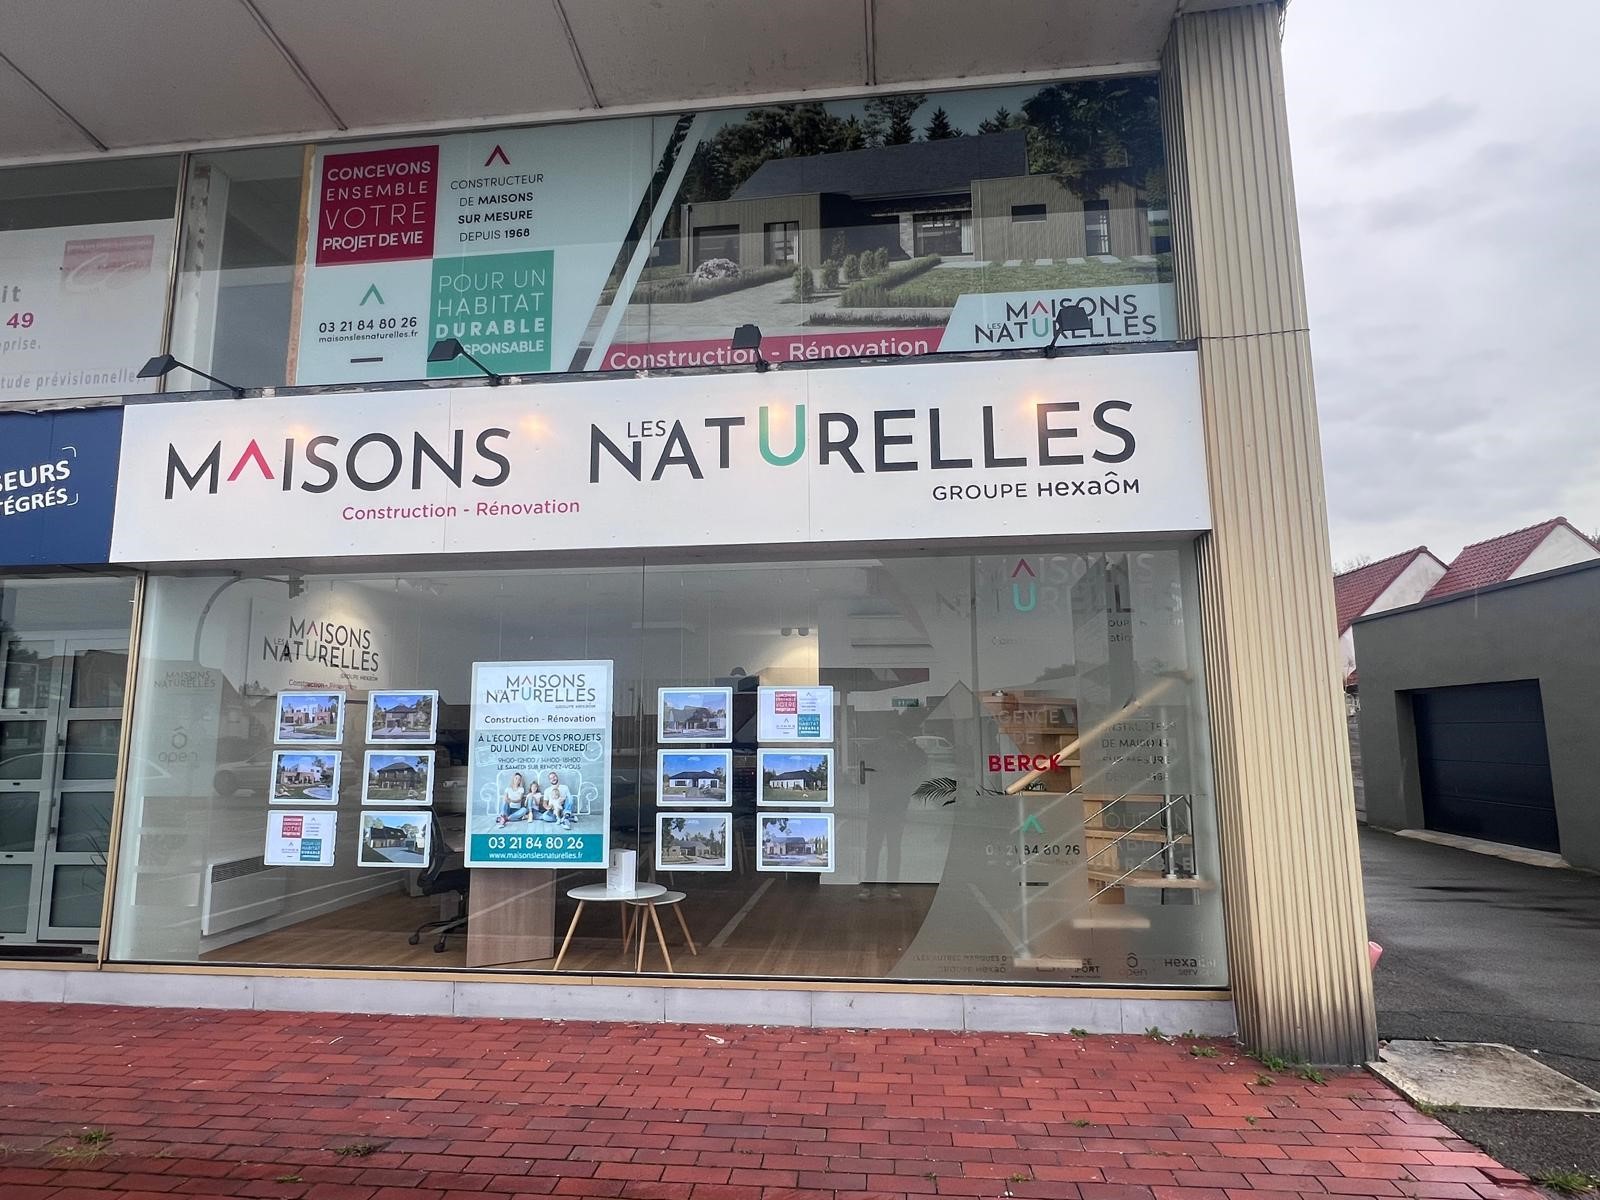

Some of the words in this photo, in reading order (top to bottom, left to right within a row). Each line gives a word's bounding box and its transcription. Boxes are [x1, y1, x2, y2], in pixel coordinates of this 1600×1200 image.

[327, 160, 432, 182] CONCEVONS
[450, 173, 544, 190] CONSTRUCTEUR
[326, 181, 428, 201] ENSEMBLE
[459, 196, 475, 207] DE
[477, 191, 534, 206] MAISONS
[325, 201, 427, 230] VOTRE
[457, 213, 482, 225] SUR
[484, 209, 533, 223] MESURE
[322, 232, 377, 252] PROJET
[378, 232, 397, 248] DE
[401, 230, 423, 246] VIE
[459, 229, 501, 242] DEPUIS
[504, 228, 530, 239] 1968
[439, 271, 505, 293] POUR
[513, 268, 546, 288] UN
[437, 292, 545, 318] HABITAT
[6, 312, 34, 329] 49
[319, 321, 336, 334] 03
[340, 320, 353, 332] 21
[357, 319, 375, 331] 84
[379, 318, 397, 330] 80
[401, 316, 418, 328] 26
[436, 317, 545, 339] DURABLE
[986, 322, 1002, 331] LES
[318, 329, 419, 343] maisonslesnaturelles.fr
[463, 340, 545, 355] SPONSABLE
[610, 346, 763, 370] Construction
[789, 337, 929, 361] Rénovation
[627, 419, 666, 438] LES
[164, 427, 511, 501] MAISONS
[589, 399, 1137, 484] NATURELLES
[932, 483, 1029, 501] GROUPE
[342, 503, 457, 521] Construction
[477, 498, 580, 517] Rénovation
[289, 615, 371, 650] MAISONS
[263, 635, 379, 672] NATURELLES
[506, 673, 586, 689] MAISONS
[486, 687, 597, 704] NATURELLES
[484, 715, 540, 724] Construction
[547, 713, 597, 723] Rénovation
[529, 733, 540, 742] DE
[542, 733, 561, 742] VOS
[563, 732, 602, 742] PROJETS
[490, 744, 502, 753] DU
[504, 744, 529, 753] LUNDI
[531, 744, 543, 753] AU
[546, 743, 588, 753] VENDREDI
[988, 754, 1061, 772] BERCK
[488, 836, 506, 850] 03
[509, 836, 522, 850] 21
[525, 836, 543, 850] 84
[546, 836, 563, 850] 80
[567, 836, 584, 850] 26
